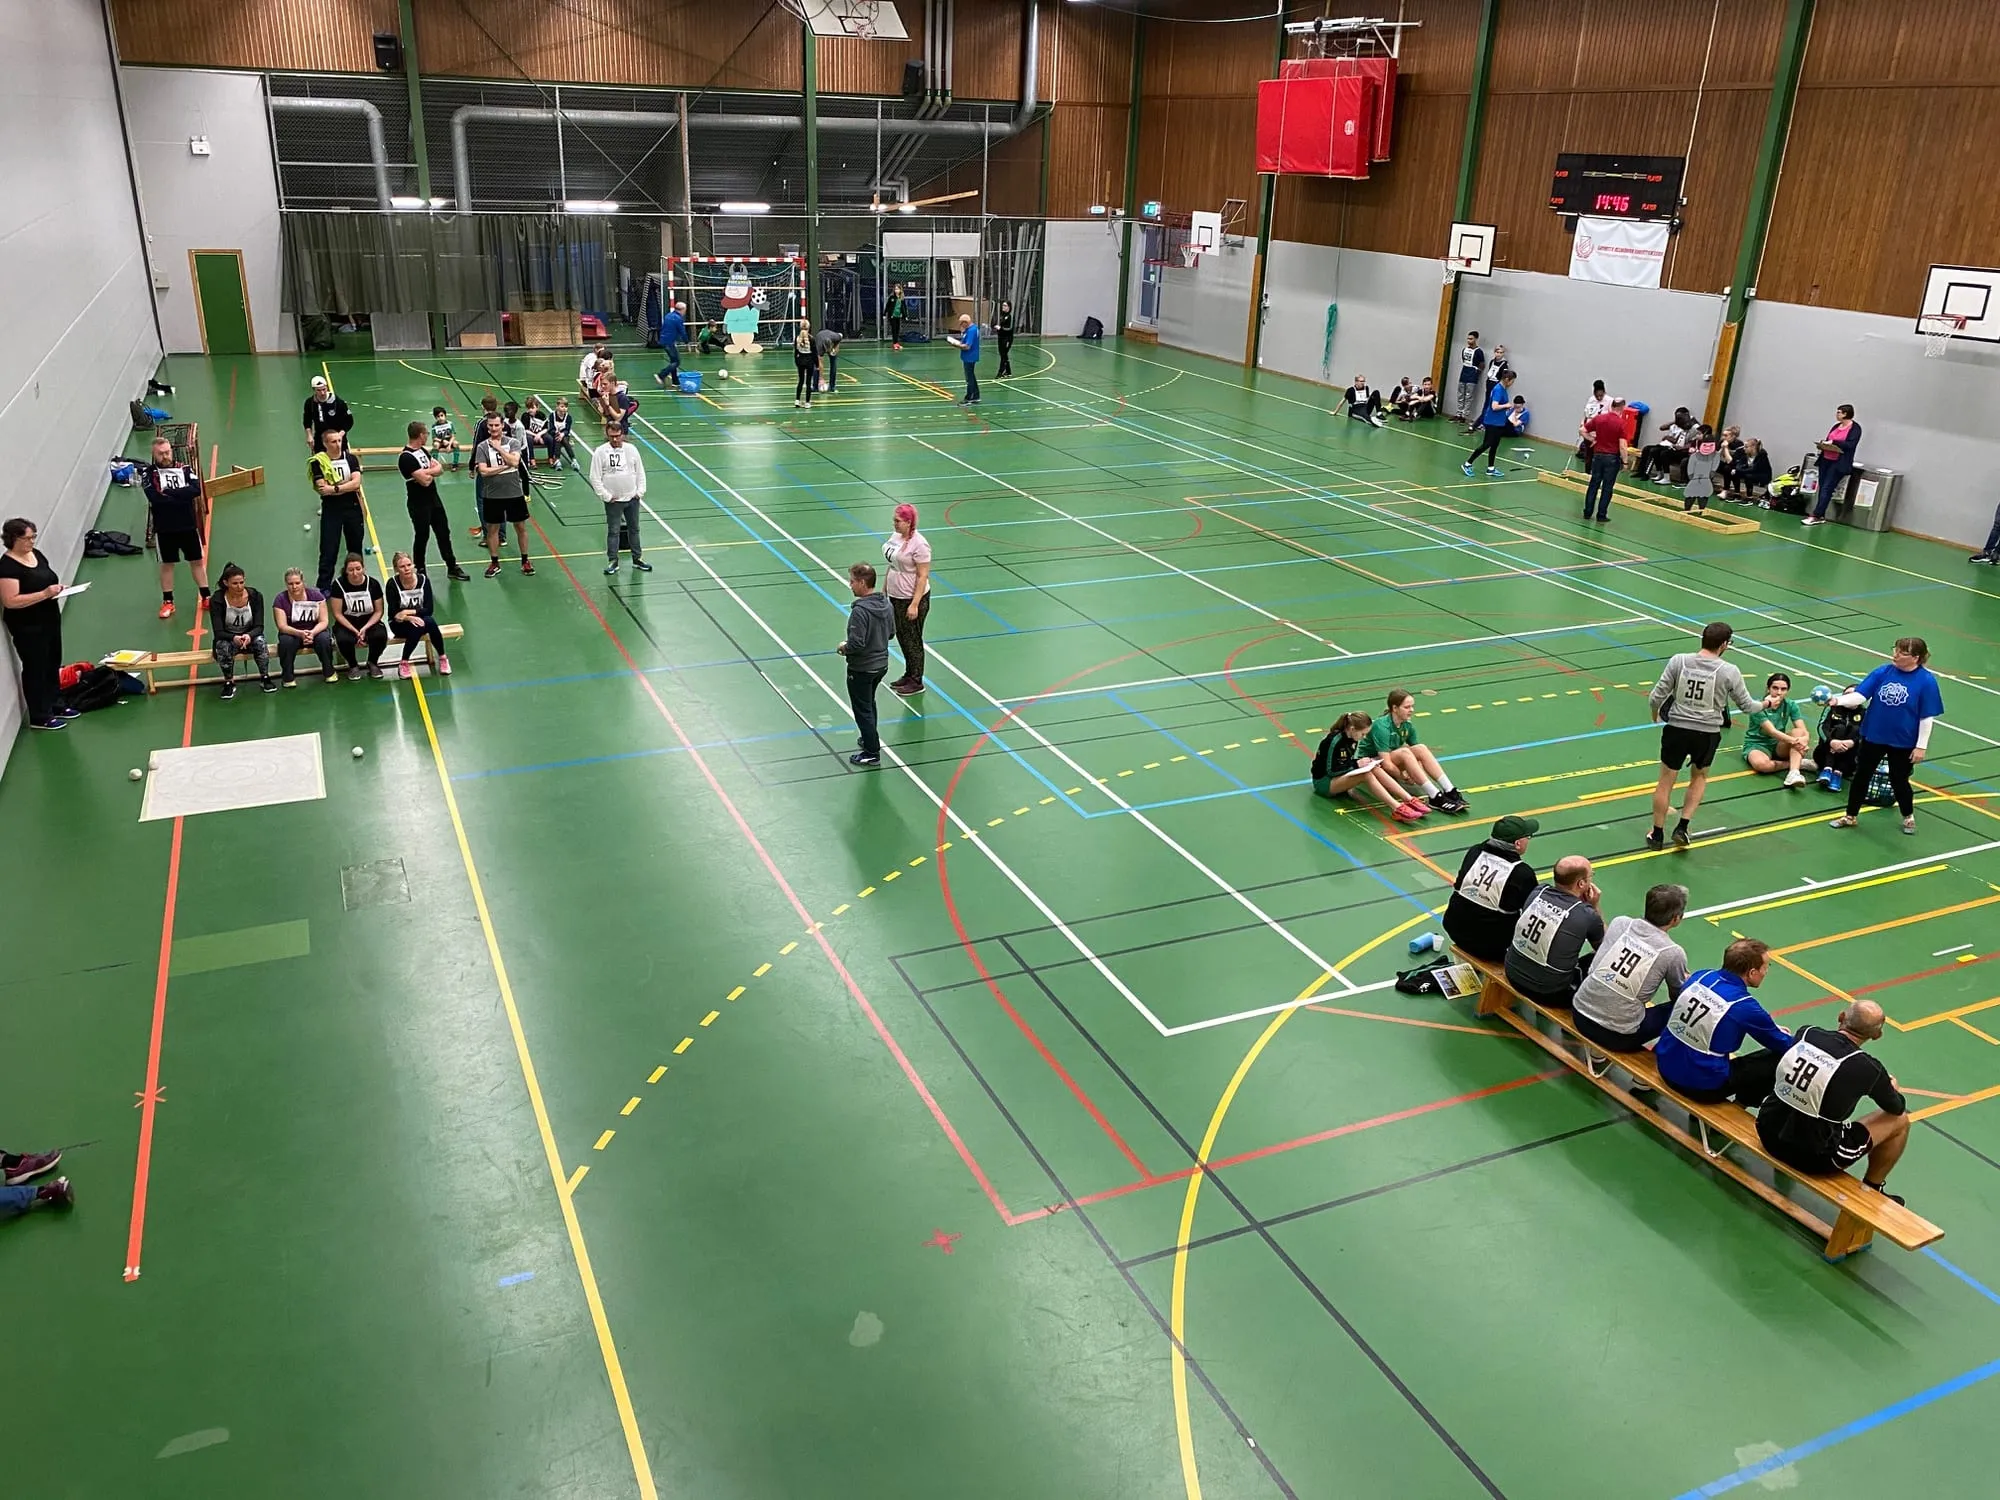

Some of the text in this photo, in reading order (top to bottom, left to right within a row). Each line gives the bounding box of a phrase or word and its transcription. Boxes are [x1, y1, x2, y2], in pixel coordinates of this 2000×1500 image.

[609, 453, 622, 468] 62
[165, 474, 180, 488] 58
[1685, 679, 1706, 701] 35
[1472, 864, 1499, 892] 34
[1521, 914, 1547, 945] 36
[1610, 947, 1642, 979] 39
[1680, 996, 1711, 1028] 37
[1784, 1056, 1819, 1093] 38
